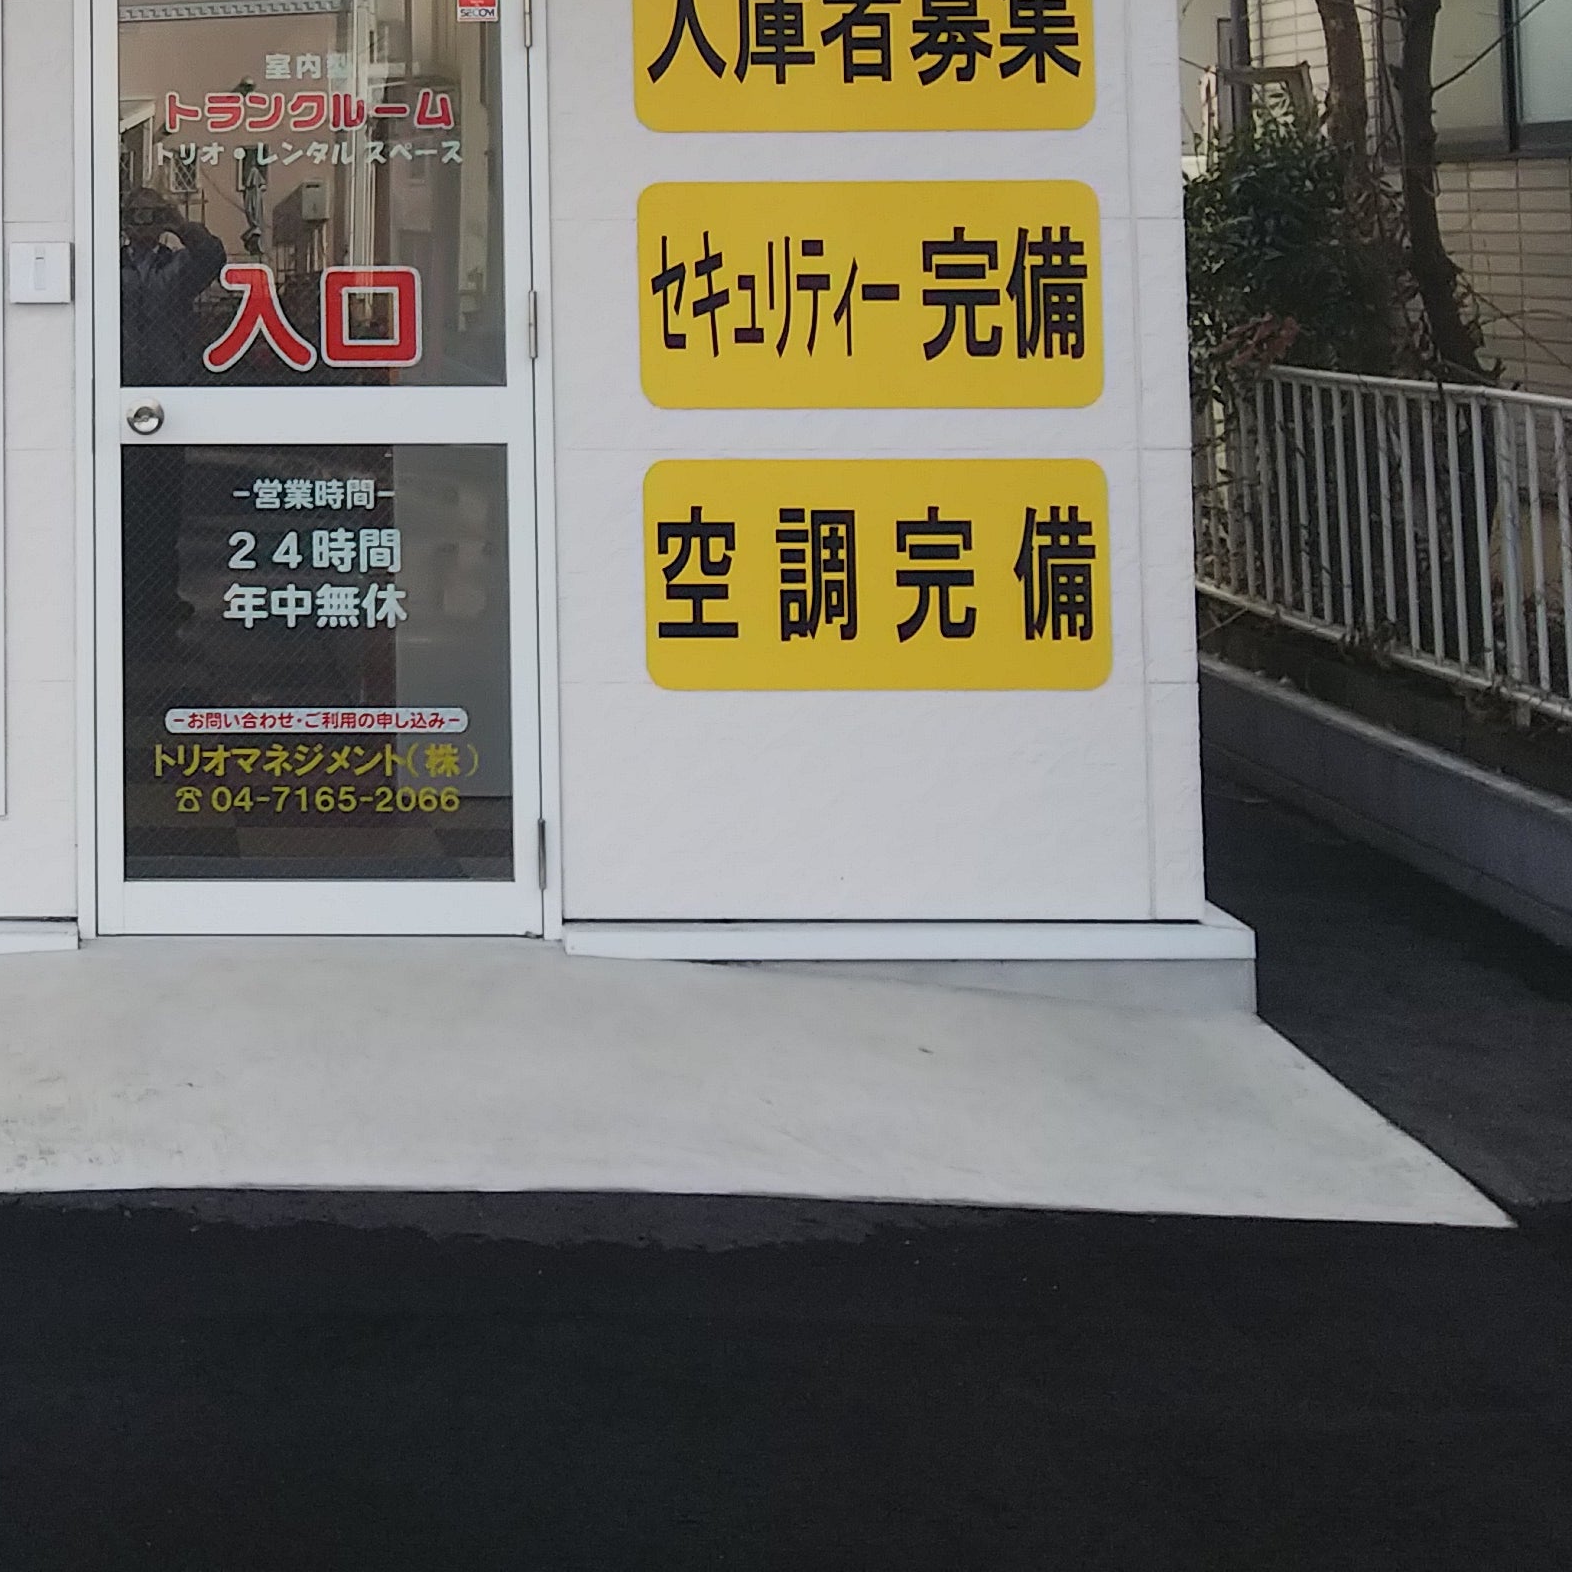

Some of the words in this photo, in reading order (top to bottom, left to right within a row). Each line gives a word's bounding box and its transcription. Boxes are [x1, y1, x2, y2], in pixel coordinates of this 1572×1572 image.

[165, 88, 455, 134] トランクルーム
[203, 263, 423, 373] 入口
[227, 527, 401, 574] 24時間
[656, 505, 1097, 642] 空調完備
[223, 583, 408, 629] 年中無休
[211, 785, 461, 813] 04-7165-2066
